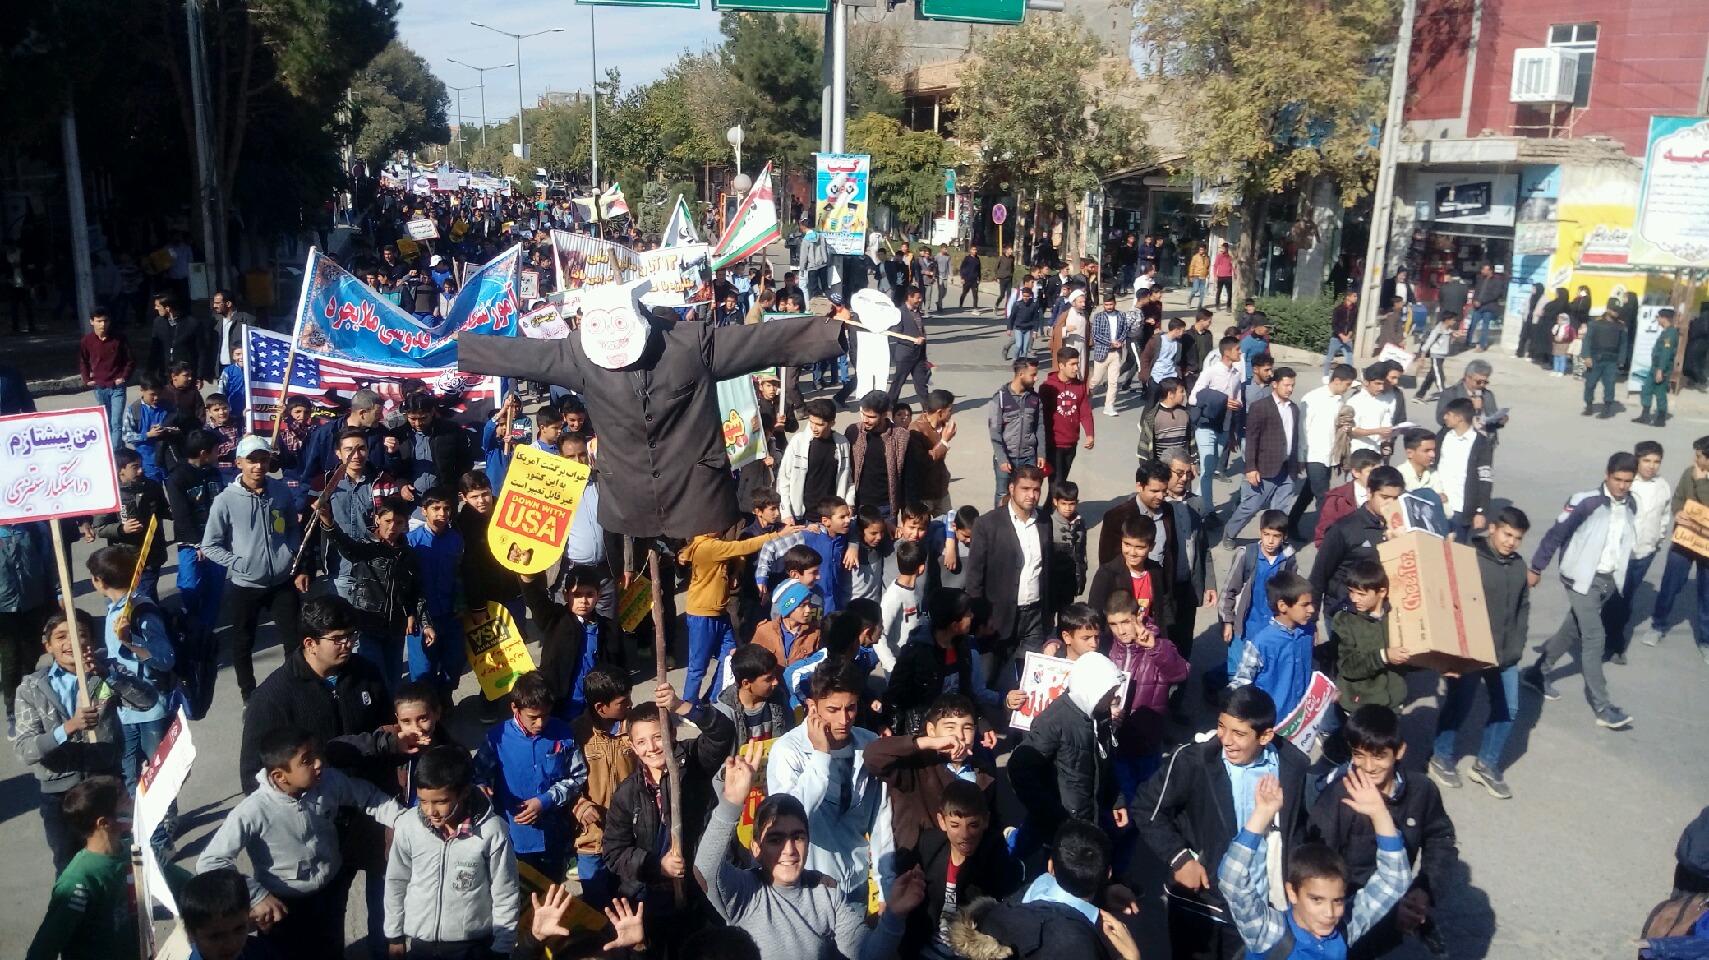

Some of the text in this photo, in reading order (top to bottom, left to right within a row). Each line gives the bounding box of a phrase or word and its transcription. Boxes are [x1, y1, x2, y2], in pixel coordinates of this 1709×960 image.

[10, 426, 98, 455] من پیشتازم
[516, 452, 540, 465] آمریکا
[510, 479, 528, 489] است
[526, 472, 567, 491] به این کشور
[565, 471, 587, 483] خواب
[544, 491, 561, 502] قابل
[559, 496, 574, 505] غیر
[512, 495, 566, 518] DOWN WITH
[504, 502, 557, 543] USA
[471, 615, 505, 646] USA
